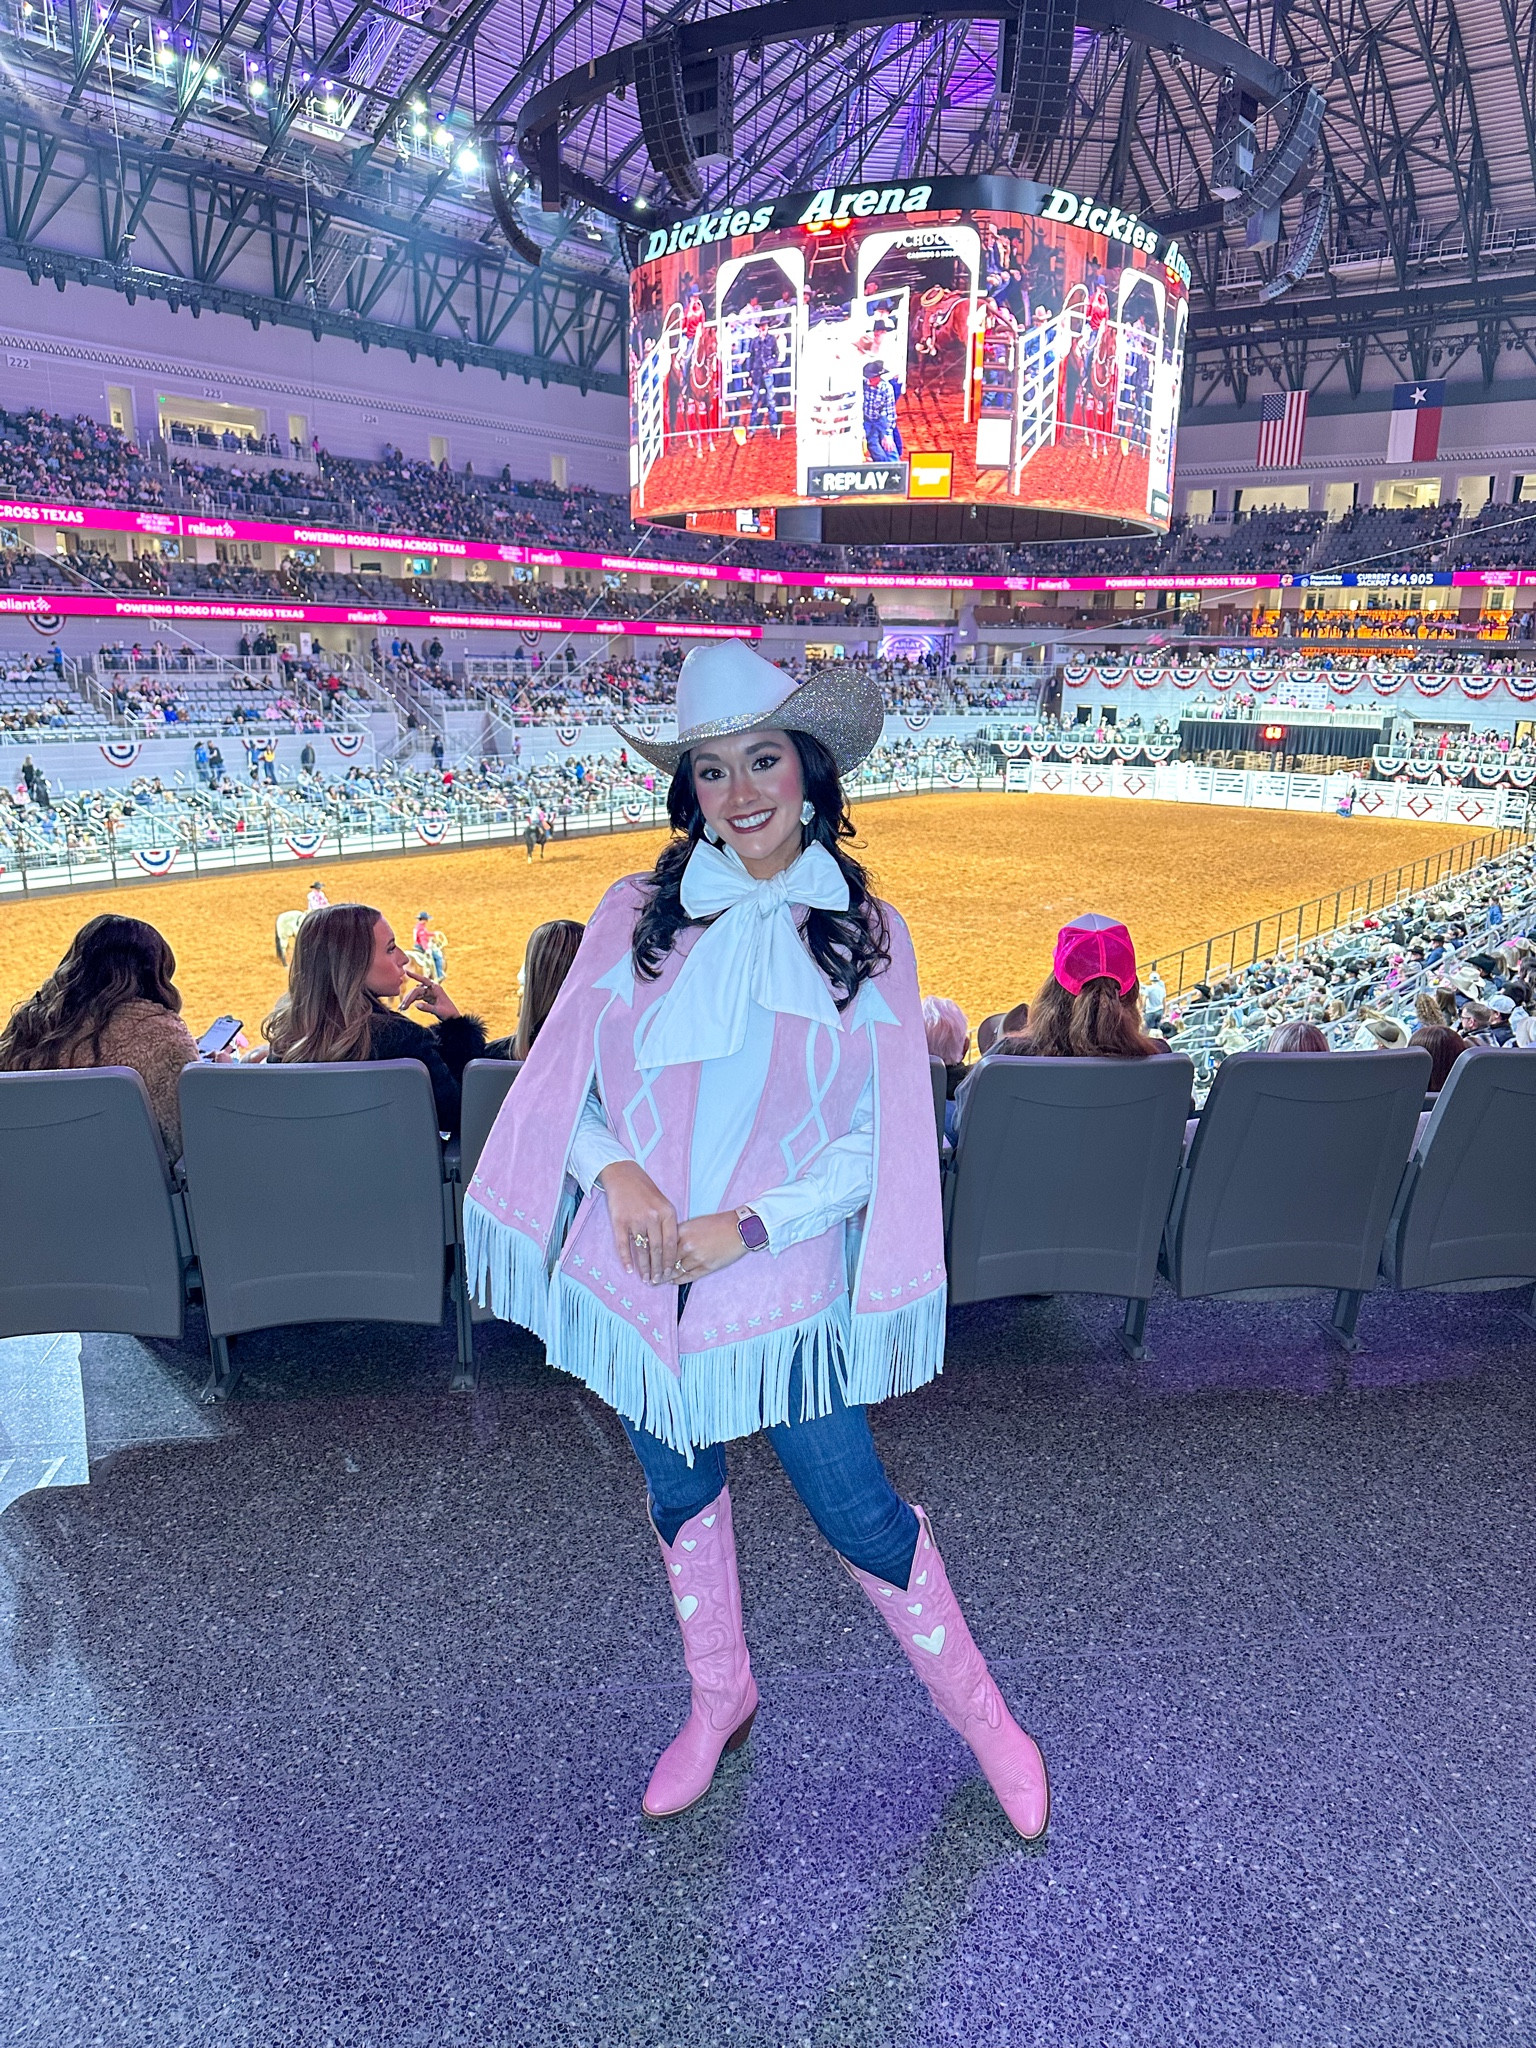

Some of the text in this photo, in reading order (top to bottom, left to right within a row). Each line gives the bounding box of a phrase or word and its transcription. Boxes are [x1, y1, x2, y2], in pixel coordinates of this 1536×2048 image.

[644, 184, 933, 263] Dickies Arena
[1041, 188, 1159, 254] Dickies
[9, 356, 30, 369] 222
[205, 389, 221, 399] 223
[363, 414, 377, 424] 224
[822, 471, 890, 492] REPLAY
[41, 508, 84, 523] TEXAS
[188, 523, 224, 537] reliant
[294, 530, 466, 555] POWERING RODEO FANS ACROSS TEXAS
[602, 557, 717, 577] POWERING RODEO FANS ACROSS TEXAS
[824, 576, 974, 587] POWERING RODEO FANS ACROSS TEXAS
[1105, 577, 1257, 588] POWERING RODEO FANS ACROSS TEXAS
[1391, 573, 1434, 586] $4,905
[116, 603, 304, 619] POWERING RODEO FANS ACROSS TEXAS
[347, 611, 378, 622] reliant
[430, 615, 562, 630] POWERING RODEO FANS ACROSS TEXAS
